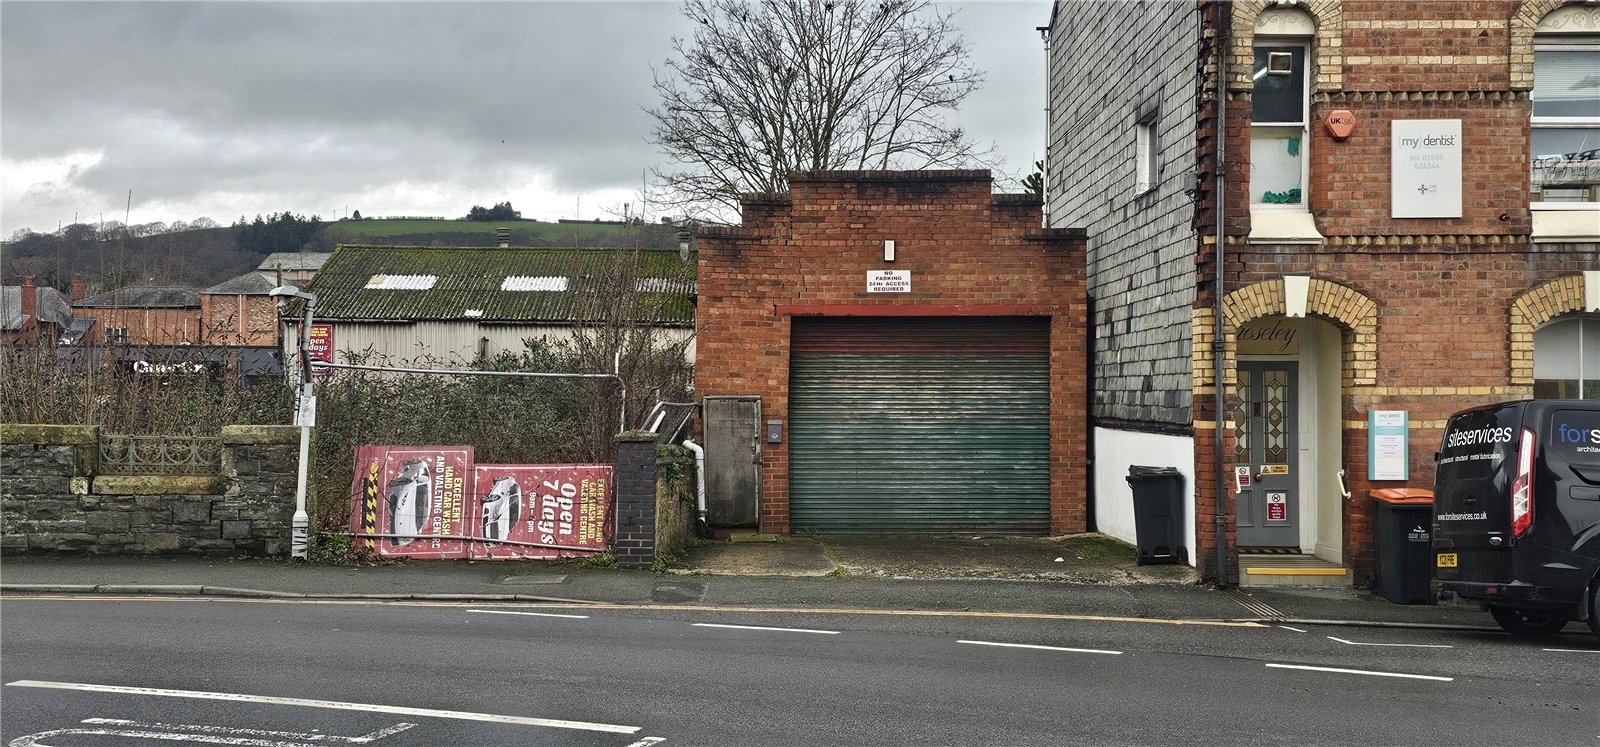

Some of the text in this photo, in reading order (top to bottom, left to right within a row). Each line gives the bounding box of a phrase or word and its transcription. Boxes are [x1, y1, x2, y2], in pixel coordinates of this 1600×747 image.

[1423, 134, 1455, 146] dentist
[1236, 320, 1297, 352] roseley
[1447, 423, 1513, 448] siteservices
[431, 455, 445, 549] AND VALETING CENTRE
[442, 466, 454, 535] HAND CAR WASH
[452, 477, 462, 524] EXCELLENT
[556, 482, 577, 535] Open
[589, 482, 597, 498] CAR
[537, 479, 559, 545] 7 days
[579, 478, 589, 545] VALETING CENTRE
[587, 523, 596, 539] AND
[595, 521, 604, 543] HAND
